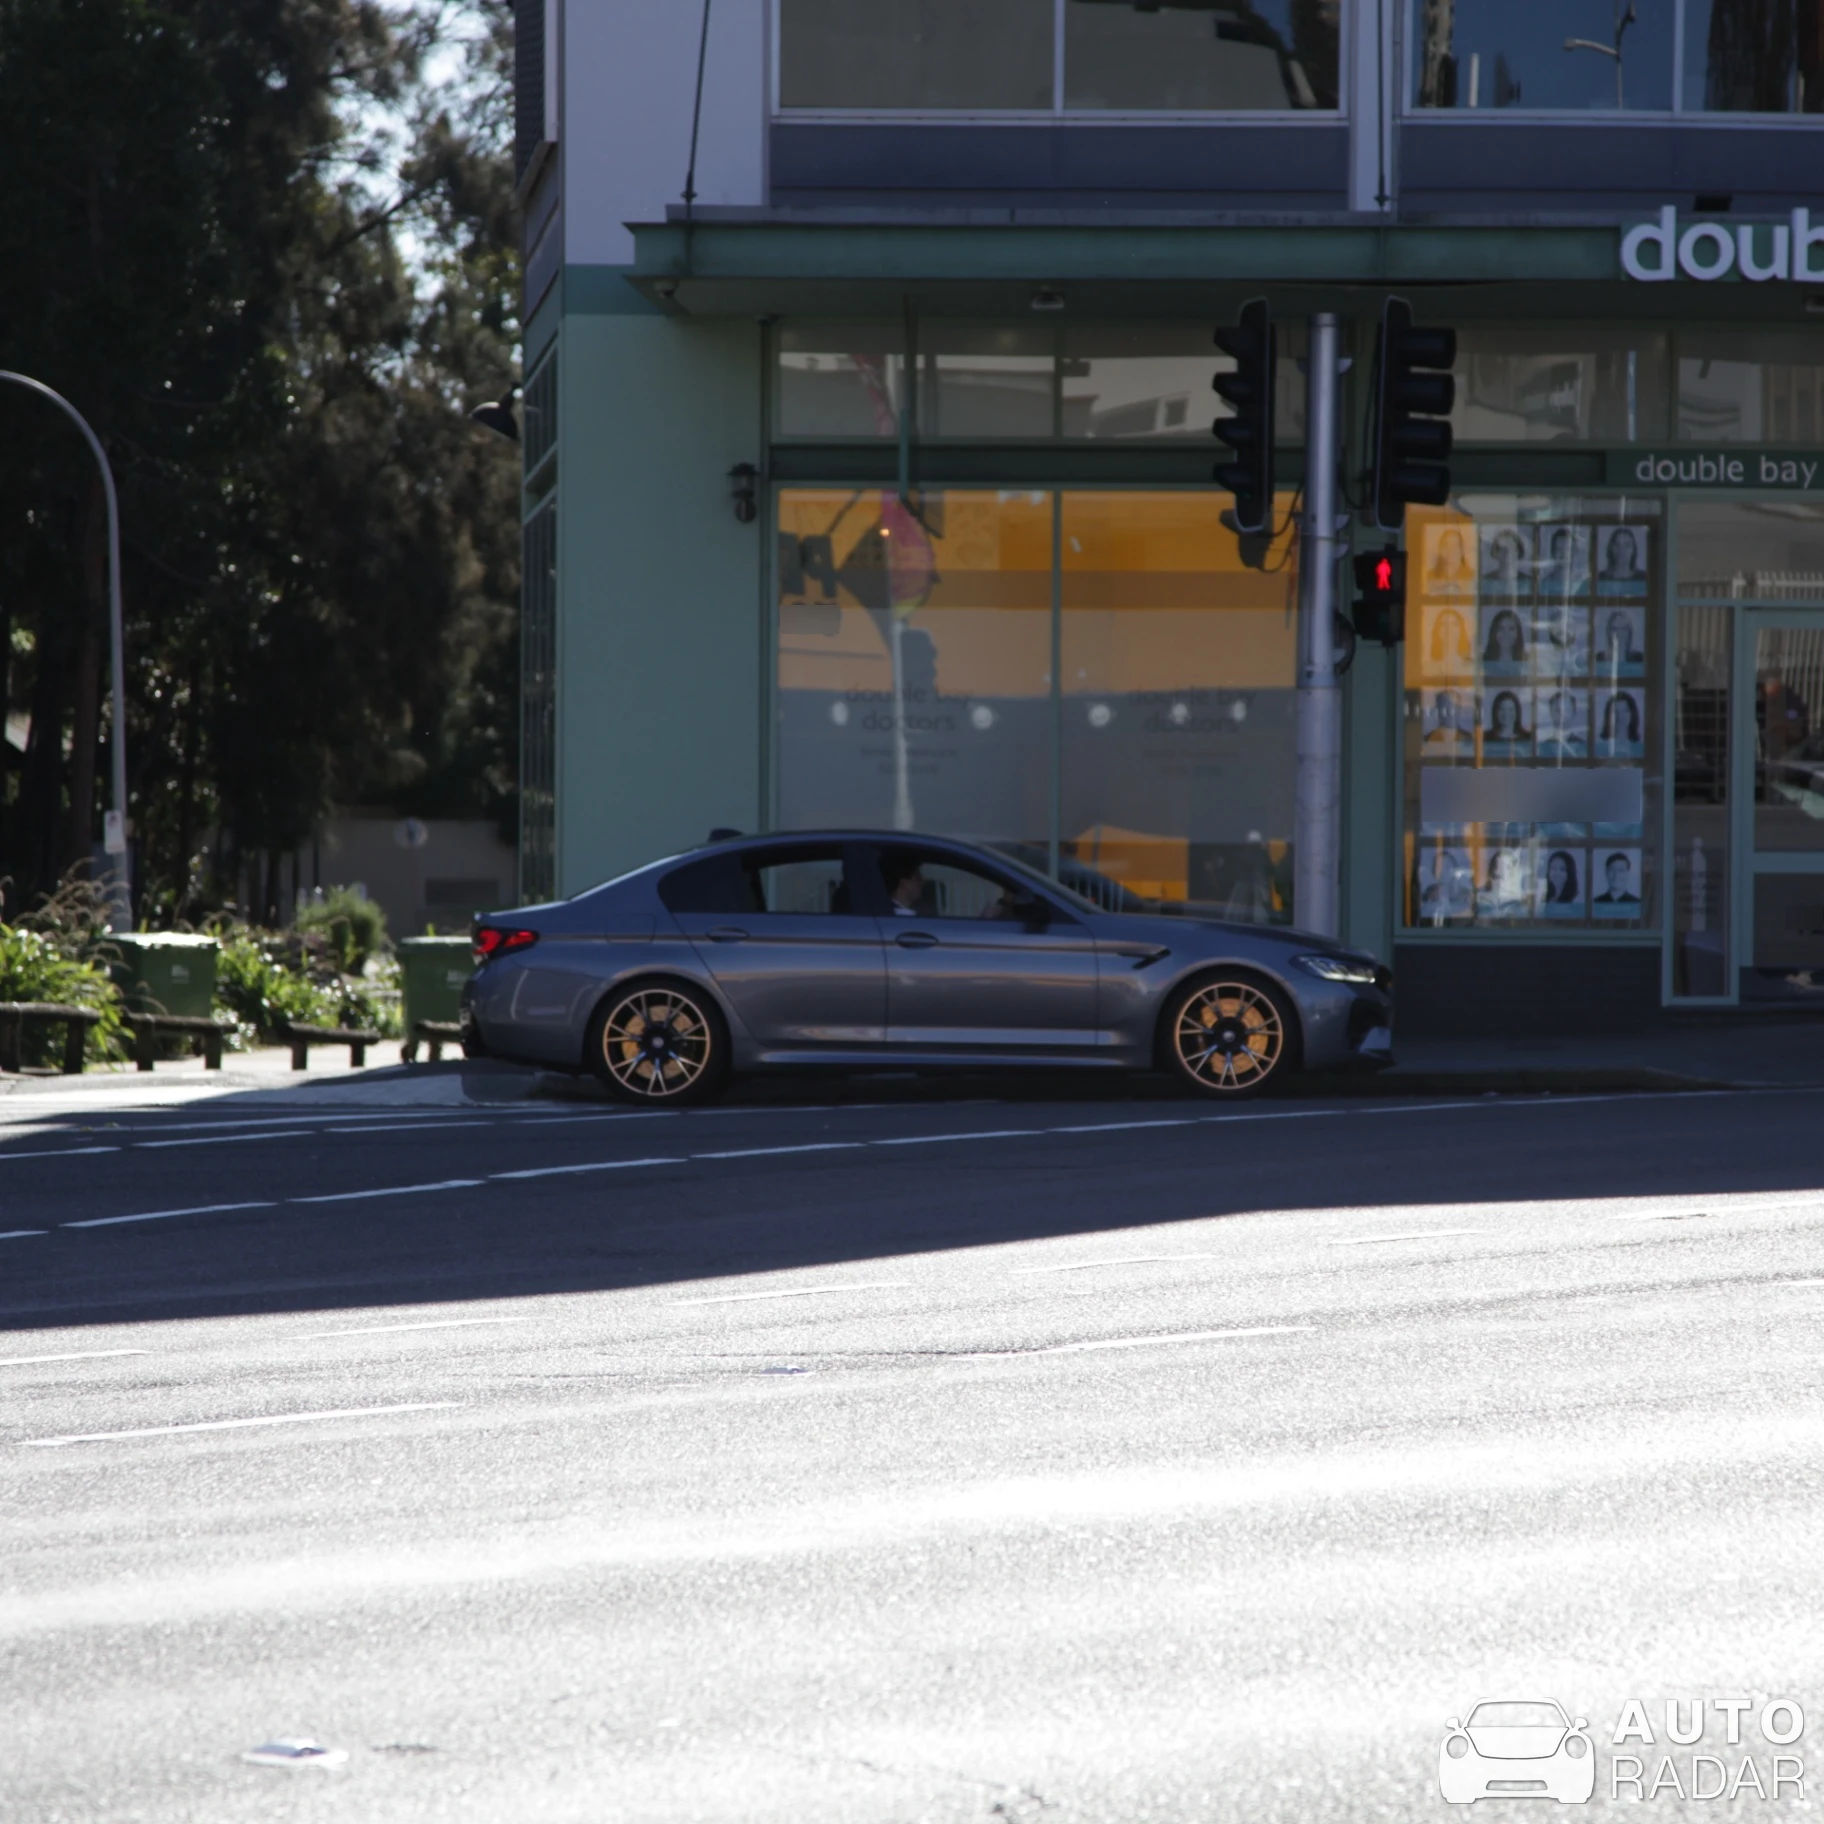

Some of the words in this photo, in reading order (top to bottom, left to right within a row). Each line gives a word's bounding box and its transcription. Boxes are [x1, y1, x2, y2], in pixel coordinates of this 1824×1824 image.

[1636, 454, 1744, 483] double
[1760, 455, 1817, 489] bay
[845, 681, 927, 703] doule
[861, 710, 957, 732] dotors
